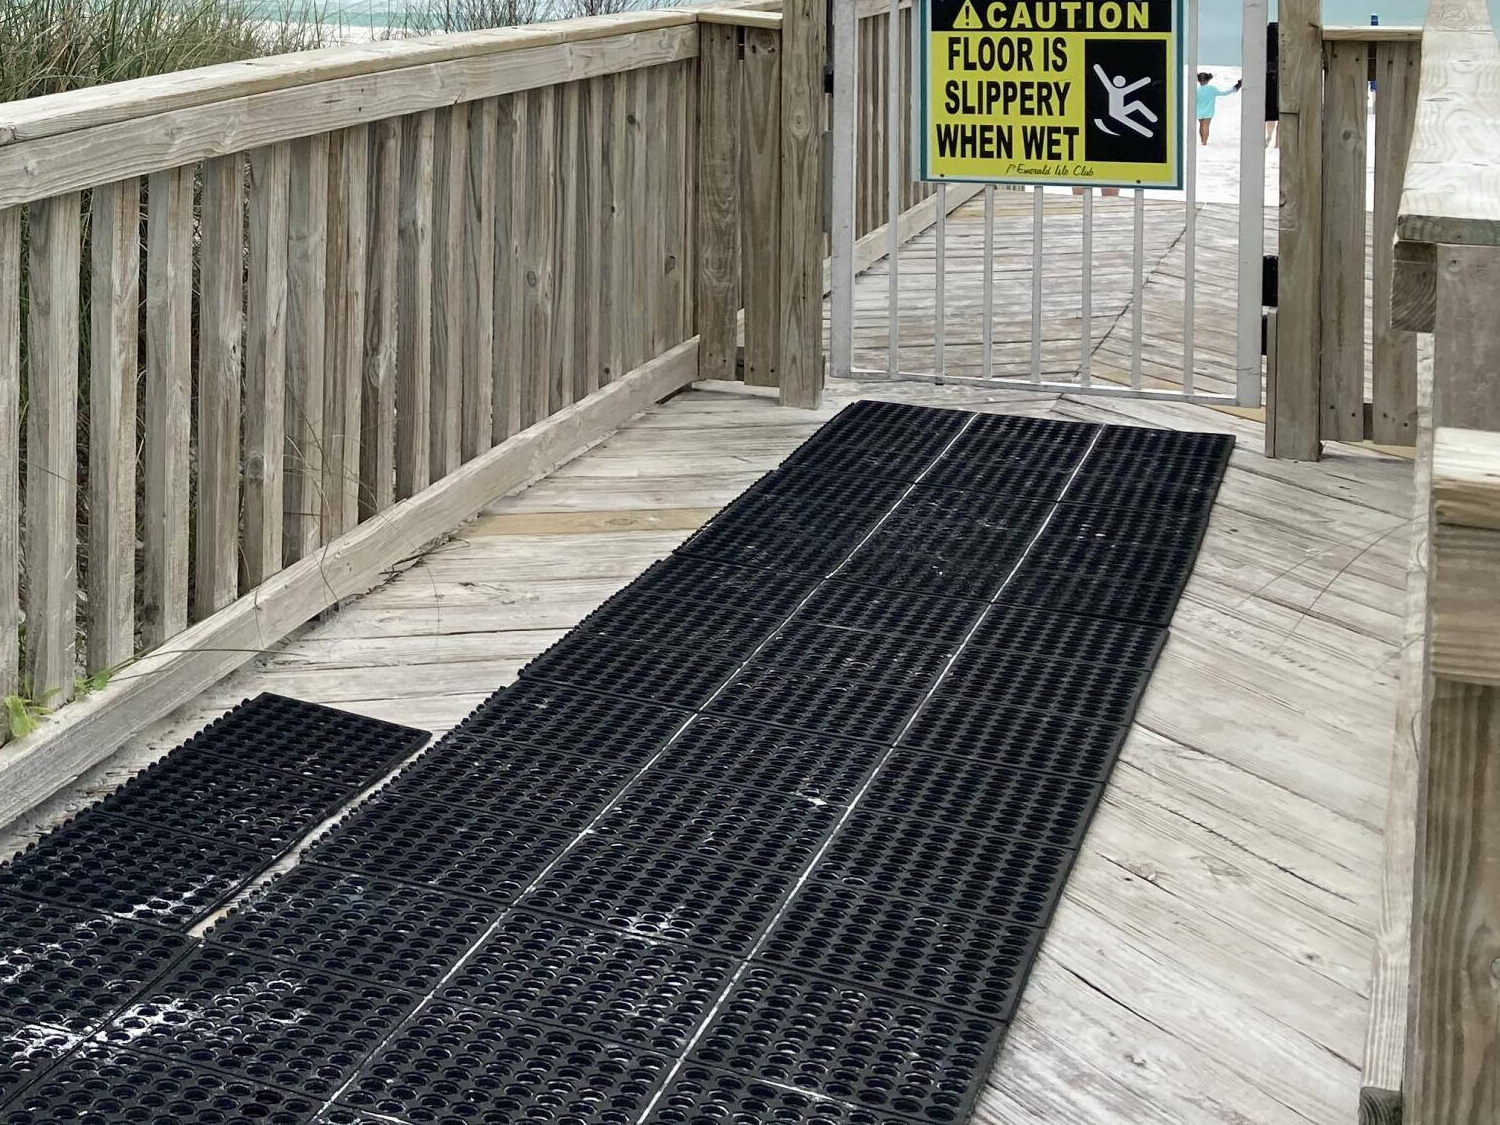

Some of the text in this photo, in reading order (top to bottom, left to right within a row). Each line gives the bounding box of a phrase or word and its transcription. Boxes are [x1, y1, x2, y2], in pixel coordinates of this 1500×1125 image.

[986, 1, 1150, 29] CAUTION
[948, 36, 1068, 73] FLOOR IS
[944, 79, 1072, 117] SLIPPERY
[936, 123, 1080, 162] WHEN WET
[1016, 163, 1052, 176] Emerald
[1072, 165, 1095, 177] Club
